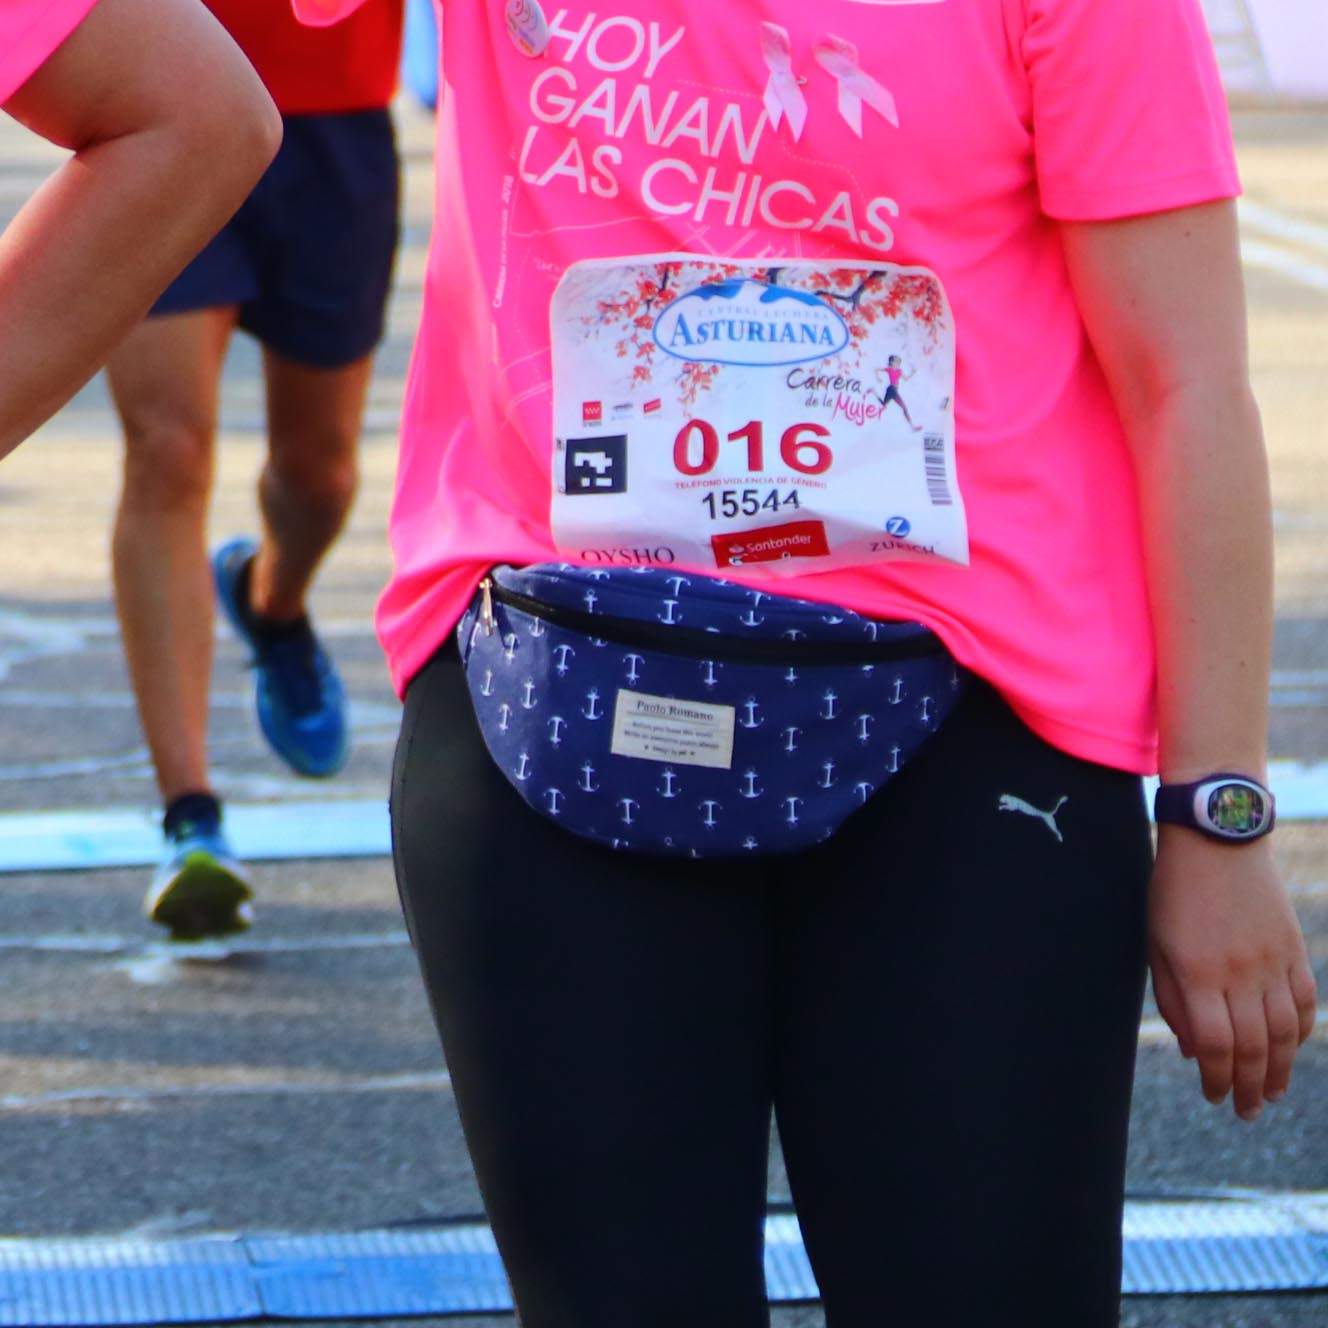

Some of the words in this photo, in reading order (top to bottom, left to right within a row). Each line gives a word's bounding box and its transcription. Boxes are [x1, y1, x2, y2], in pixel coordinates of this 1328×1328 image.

[544, 8, 685, 79] HOY
[528, 66, 771, 165] GANAN
[518, 125, 623, 199] LAS
[641, 158, 900, 252] CHICAS
[669, 312, 835, 347] ASTURIANA
[786, 367, 862, 394] Carrera
[805, 393, 820, 408] de
[821, 393, 833, 408] la
[832, 393, 887, 426] Mujer
[672, 418, 834, 476] 016
[702, 488, 802, 520] 15544
[580, 545, 676, 566] OYSHO
[746, 532, 812, 556] Santander
[868, 539, 936, 556] ZURICH
